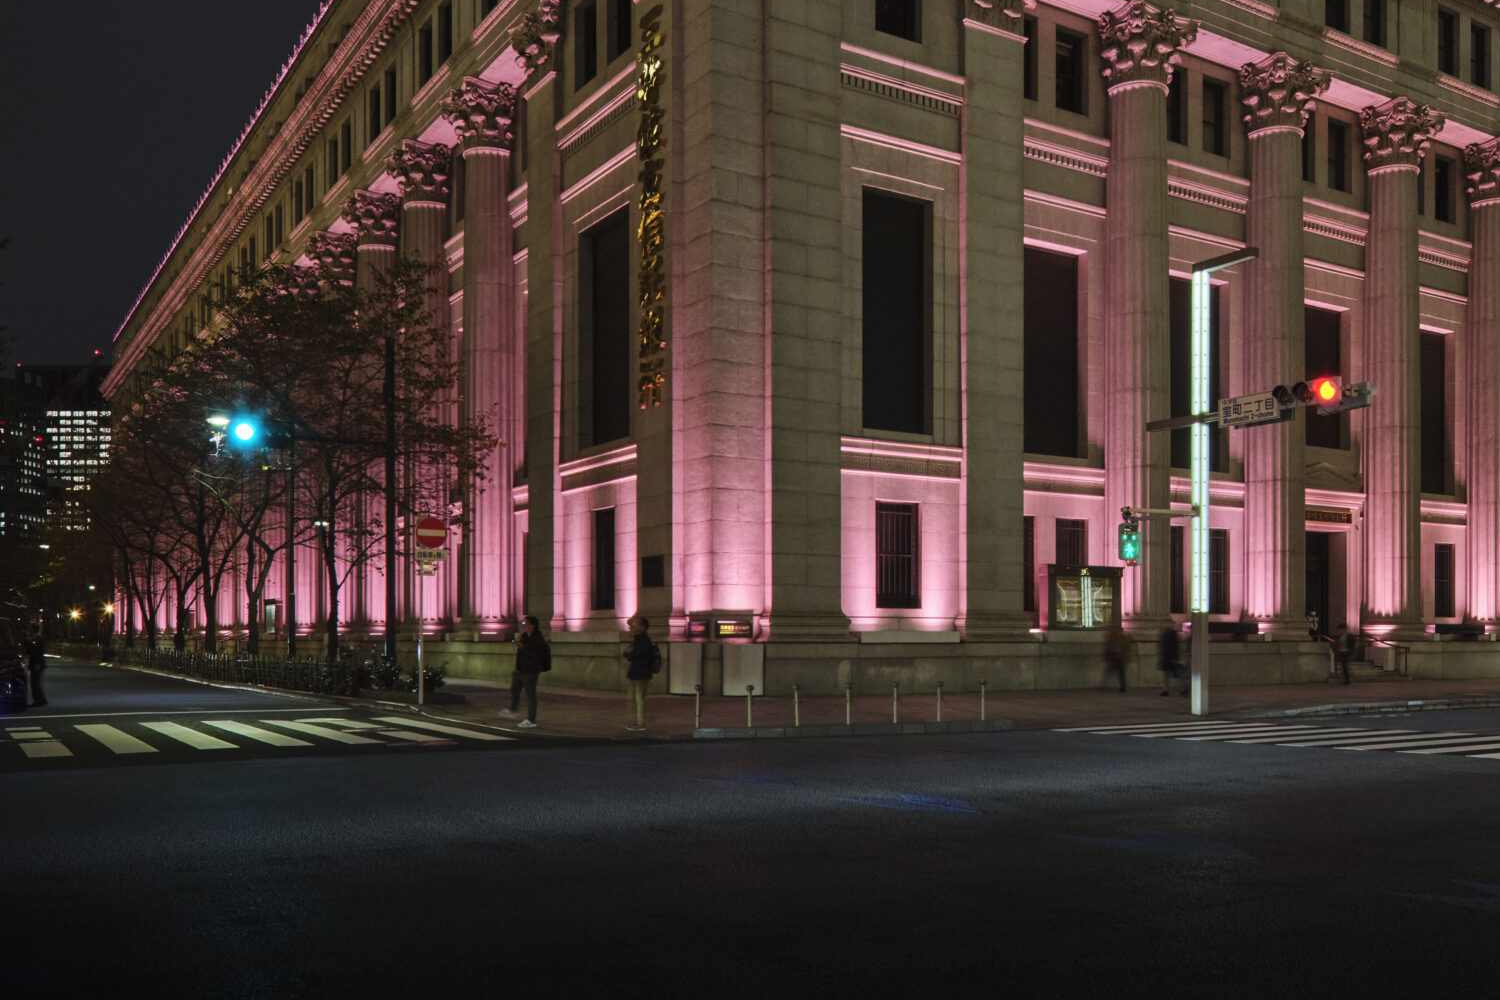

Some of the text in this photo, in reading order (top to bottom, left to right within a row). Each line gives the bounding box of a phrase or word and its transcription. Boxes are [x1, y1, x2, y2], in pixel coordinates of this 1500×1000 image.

[1223, 398, 1274, 417] 室町二丁目
